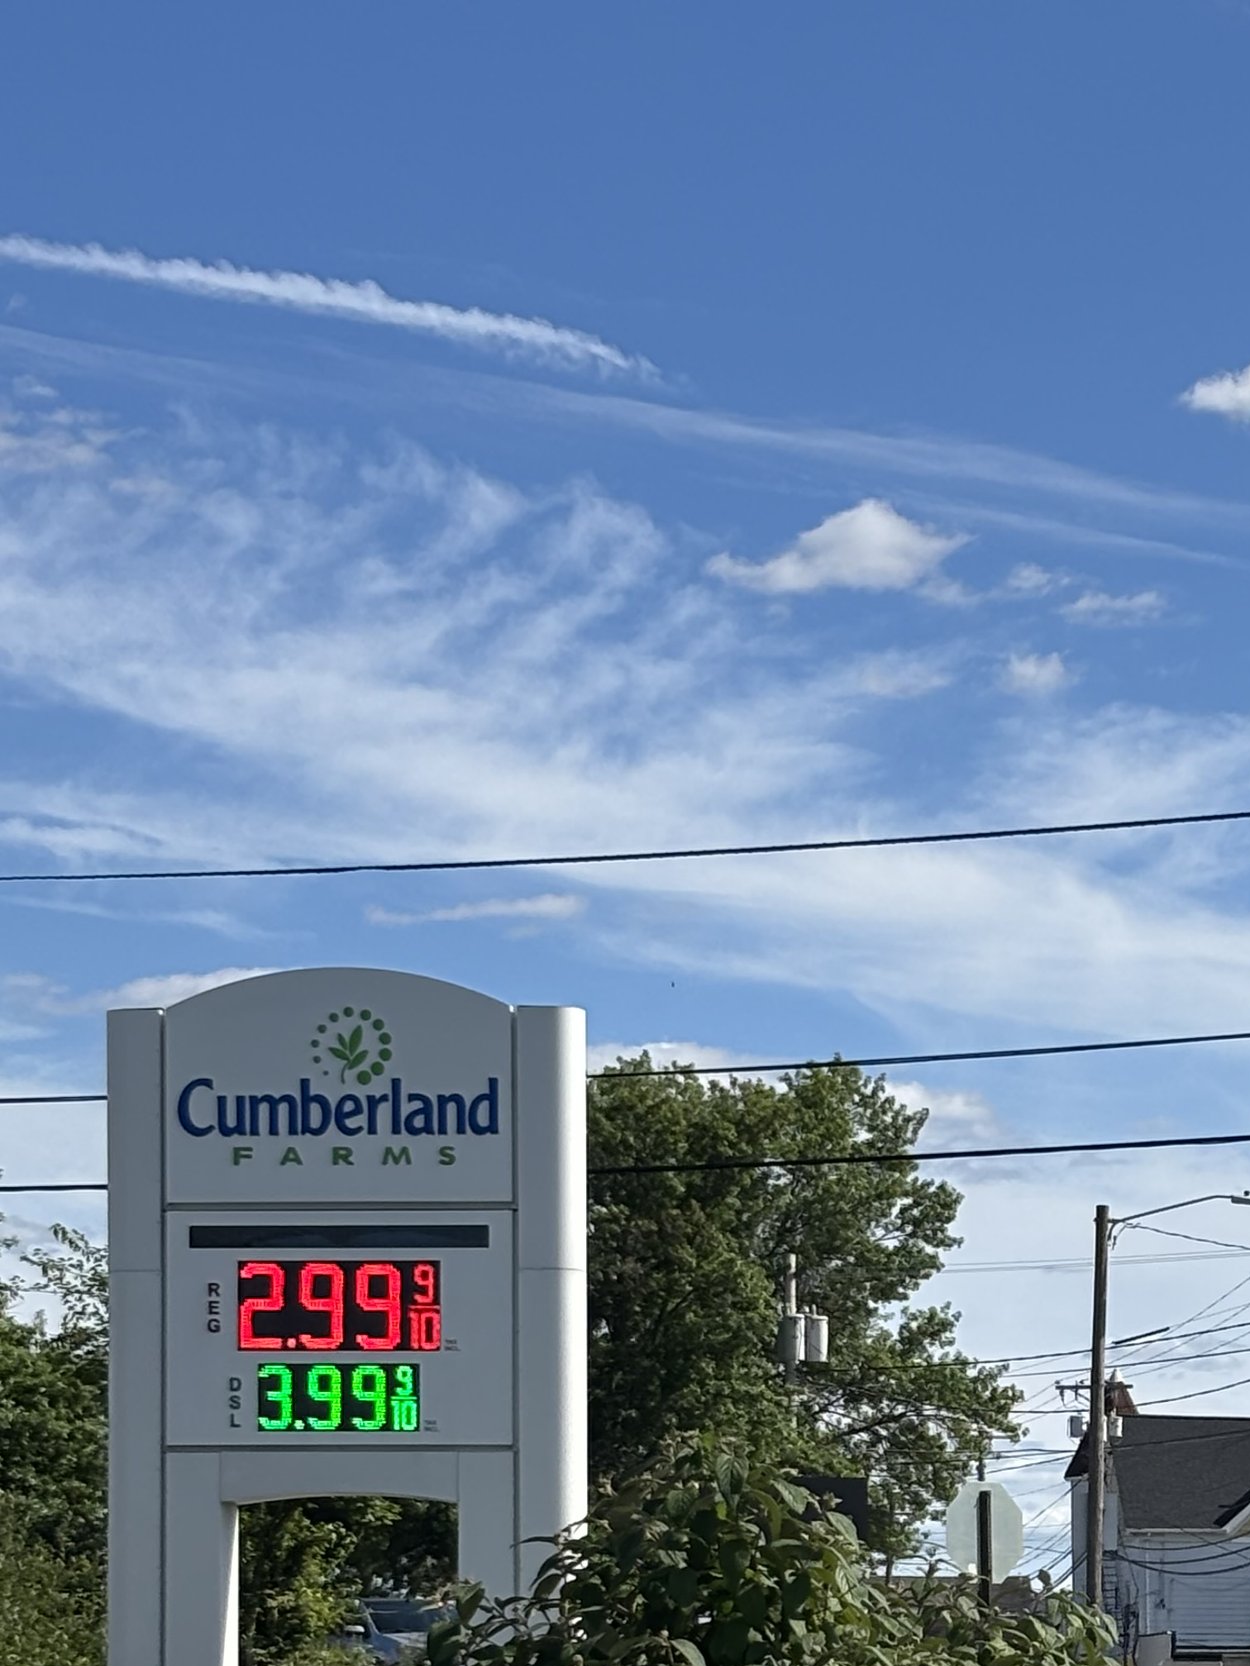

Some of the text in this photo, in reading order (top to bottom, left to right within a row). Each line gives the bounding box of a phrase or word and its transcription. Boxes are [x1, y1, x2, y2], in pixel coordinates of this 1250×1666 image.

[177, 1077, 499, 1137] Cumberland
[232, 1146, 457, 1166] FARMS
[207, 1283, 221, 1333] REG
[240, 1263, 402, 1349] 2.99
[229, 1377, 242, 1428] DSL
[258, 1366, 387, 1430] 3.99
